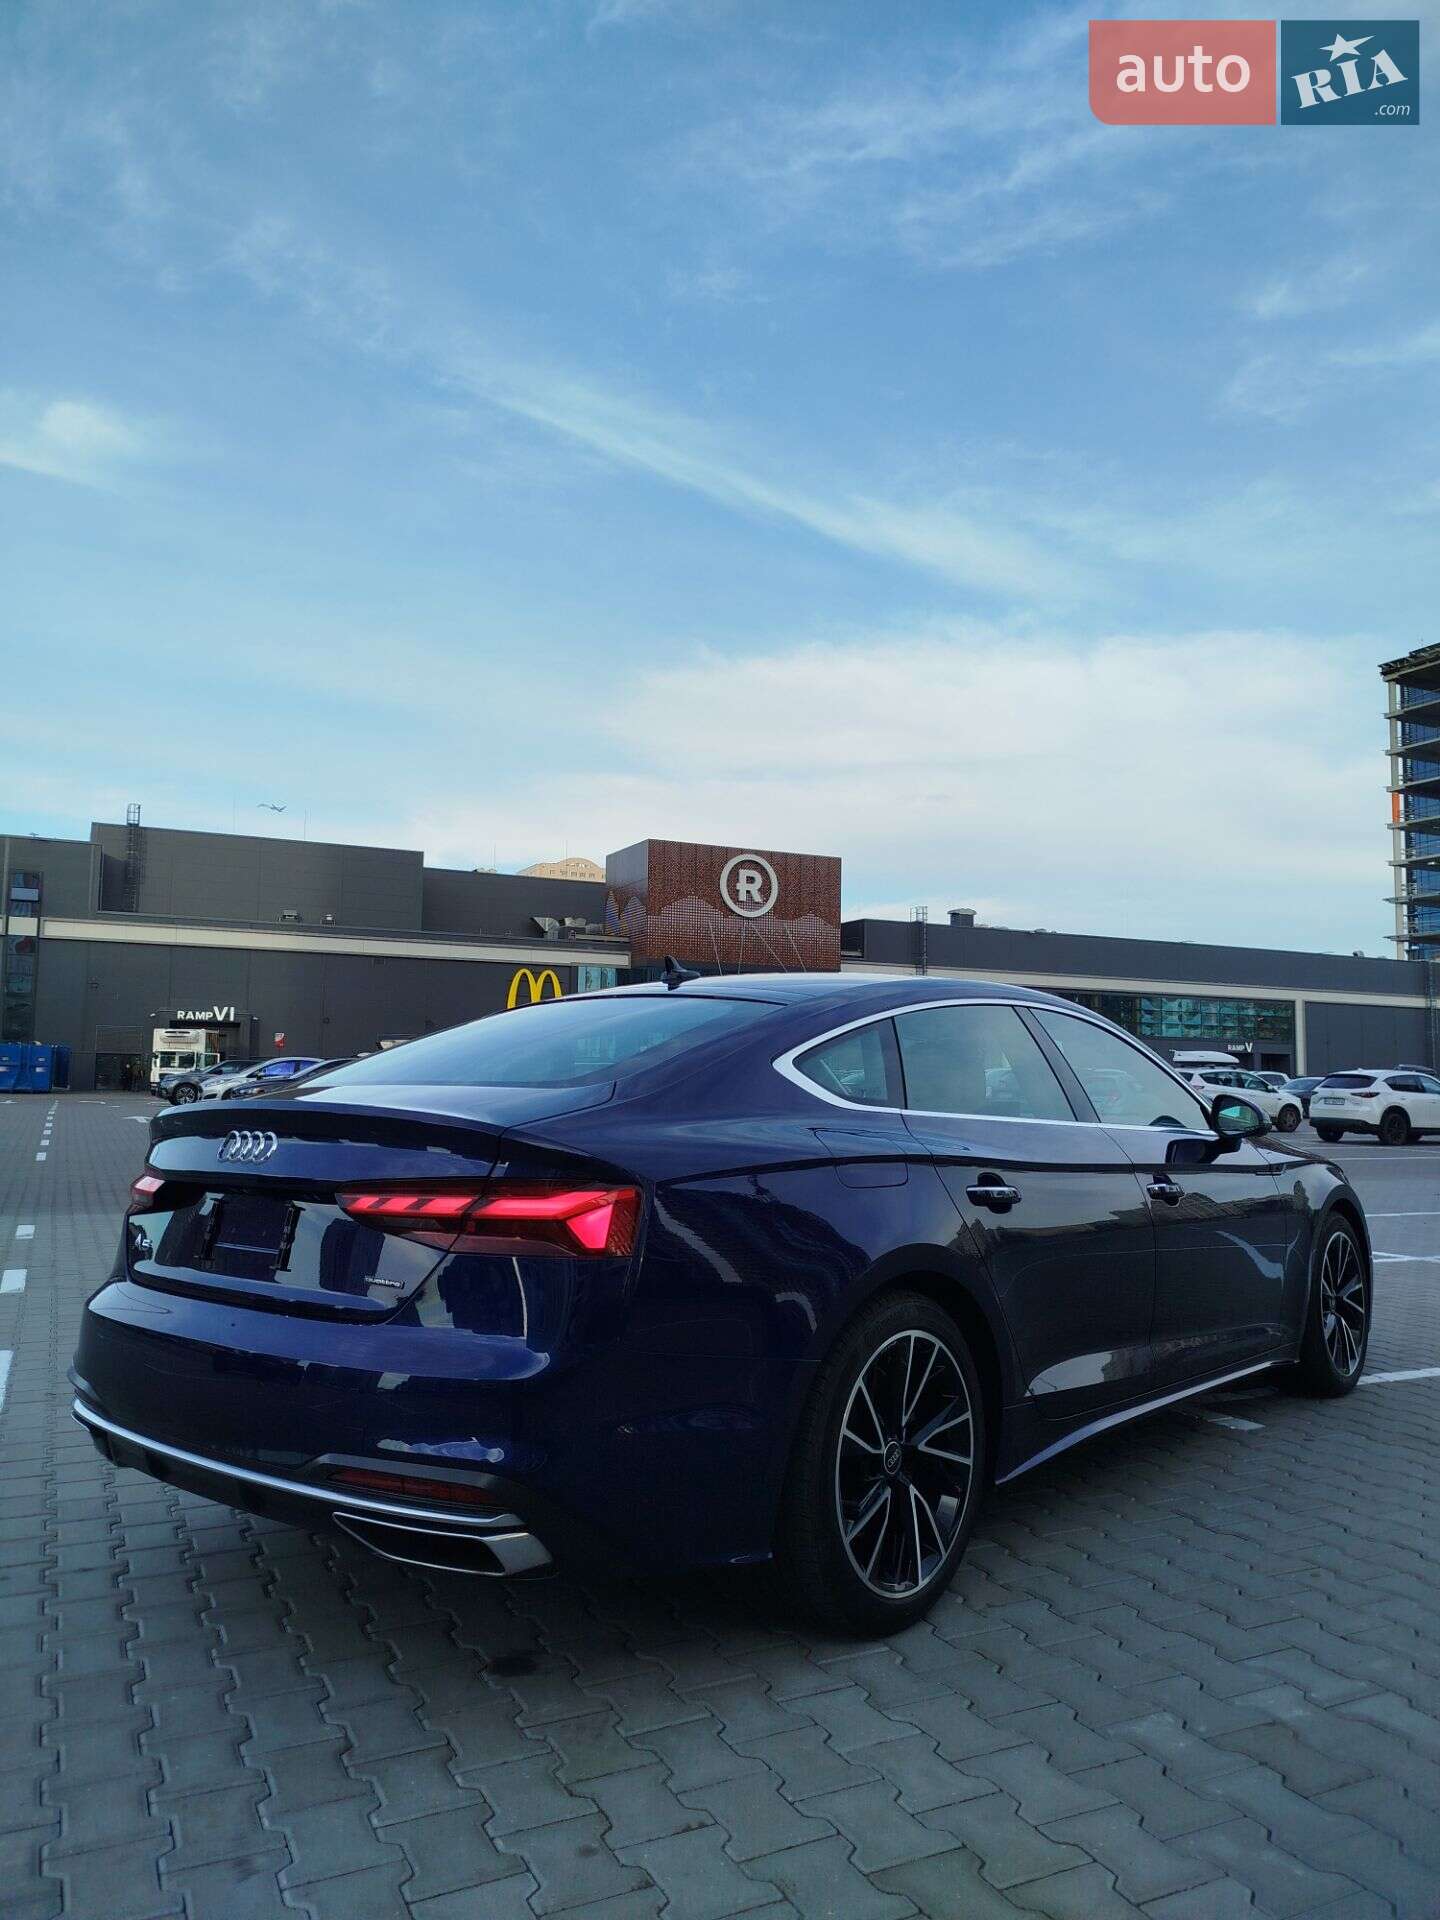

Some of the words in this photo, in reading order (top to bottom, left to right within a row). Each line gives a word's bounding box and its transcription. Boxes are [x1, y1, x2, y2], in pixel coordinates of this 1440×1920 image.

[177, 1010, 214, 1021] RAMP
[213, 1006, 236, 1021] VI
[1227, 1044, 1245, 1052] RAMP
[1245, 1042, 1253, 1053] V
